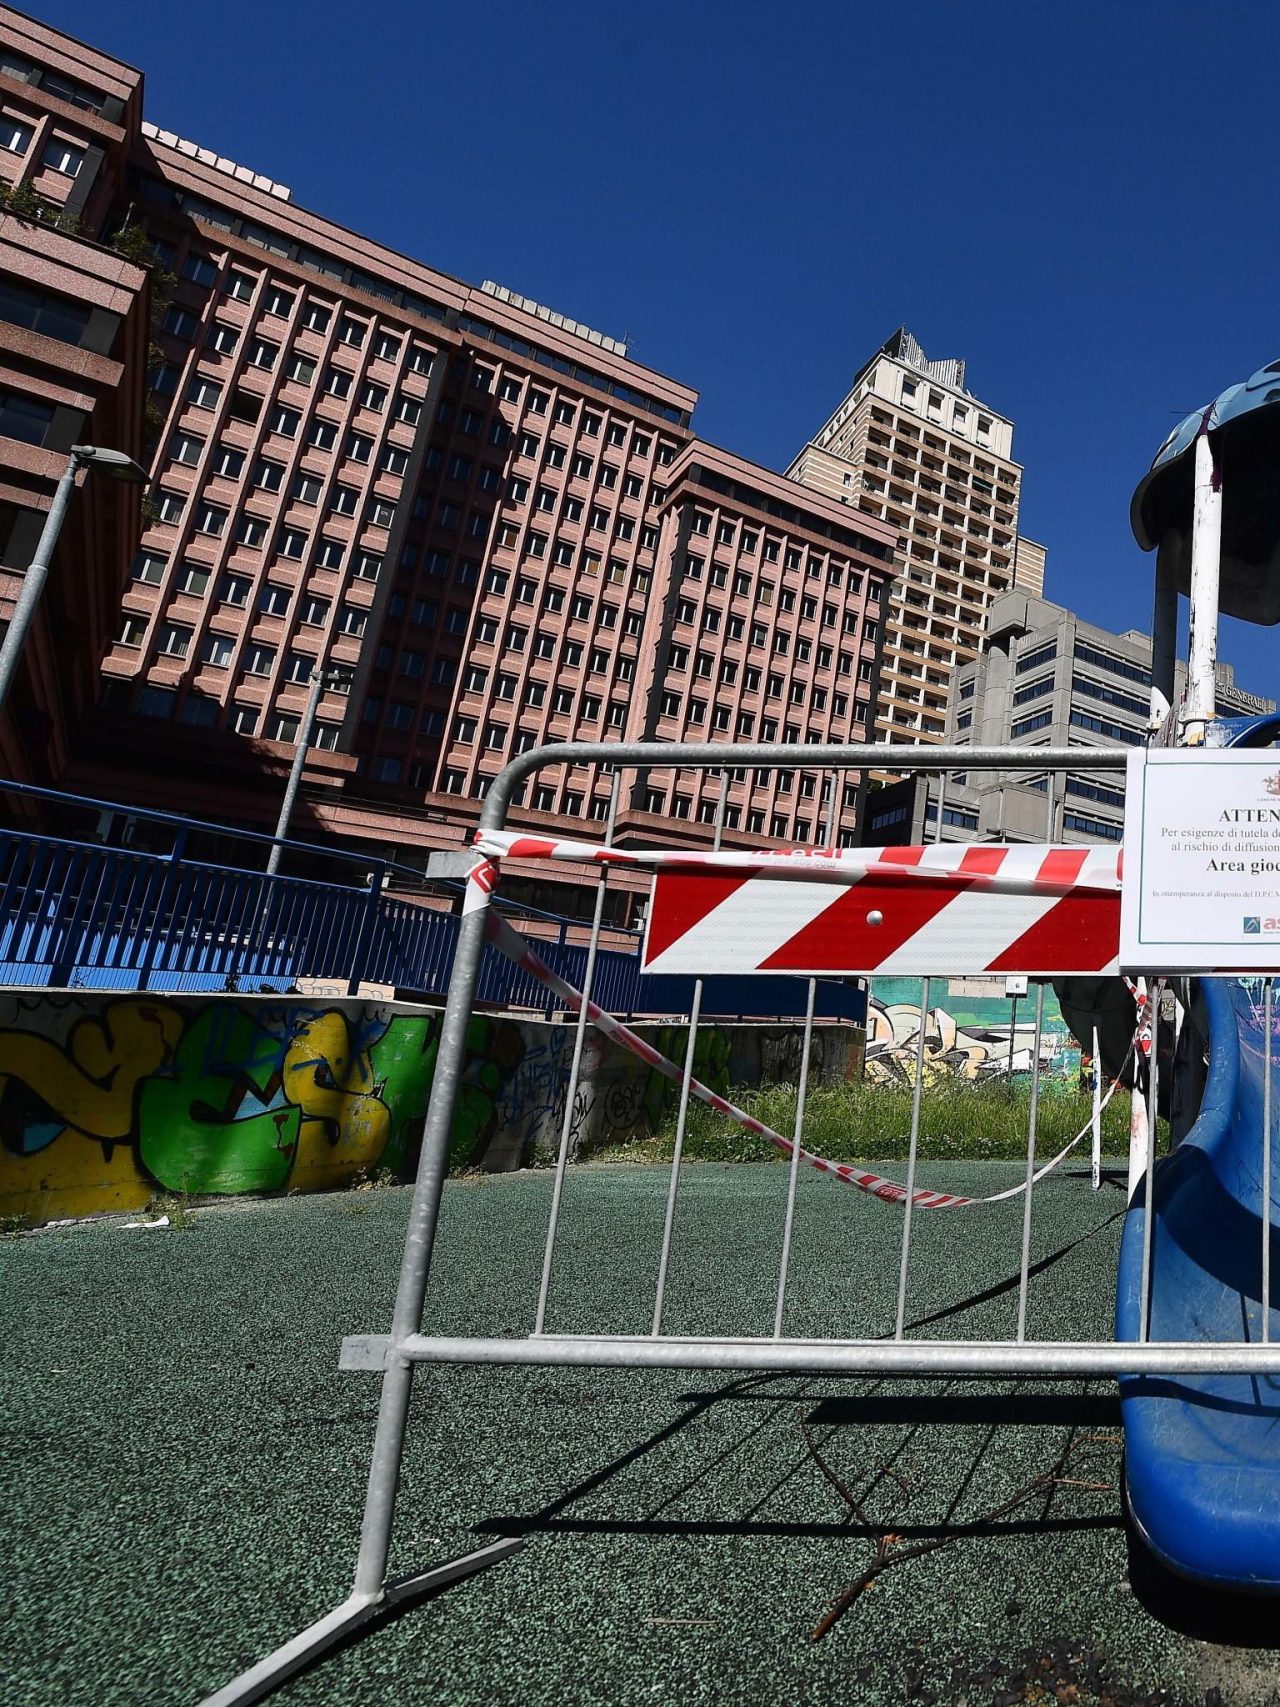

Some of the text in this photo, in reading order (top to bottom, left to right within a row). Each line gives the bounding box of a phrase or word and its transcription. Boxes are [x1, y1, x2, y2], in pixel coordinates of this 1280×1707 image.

[1161, 827, 1178, 838] Per
[1180, 827, 1224, 840] esigenze
[1228, 827, 1238, 838] di
[1241, 827, 1268, 839] tutela
[1171, 841, 1181, 852] al
[1184, 841, 1218, 852] rischio
[1222, 841, 1232, 852] di
[1206, 857, 1246, 872] Area
[1207, 889, 1213, 898] al
[1214, 890, 1241, 899] disposto
[1242, 890, 1253, 898] del
